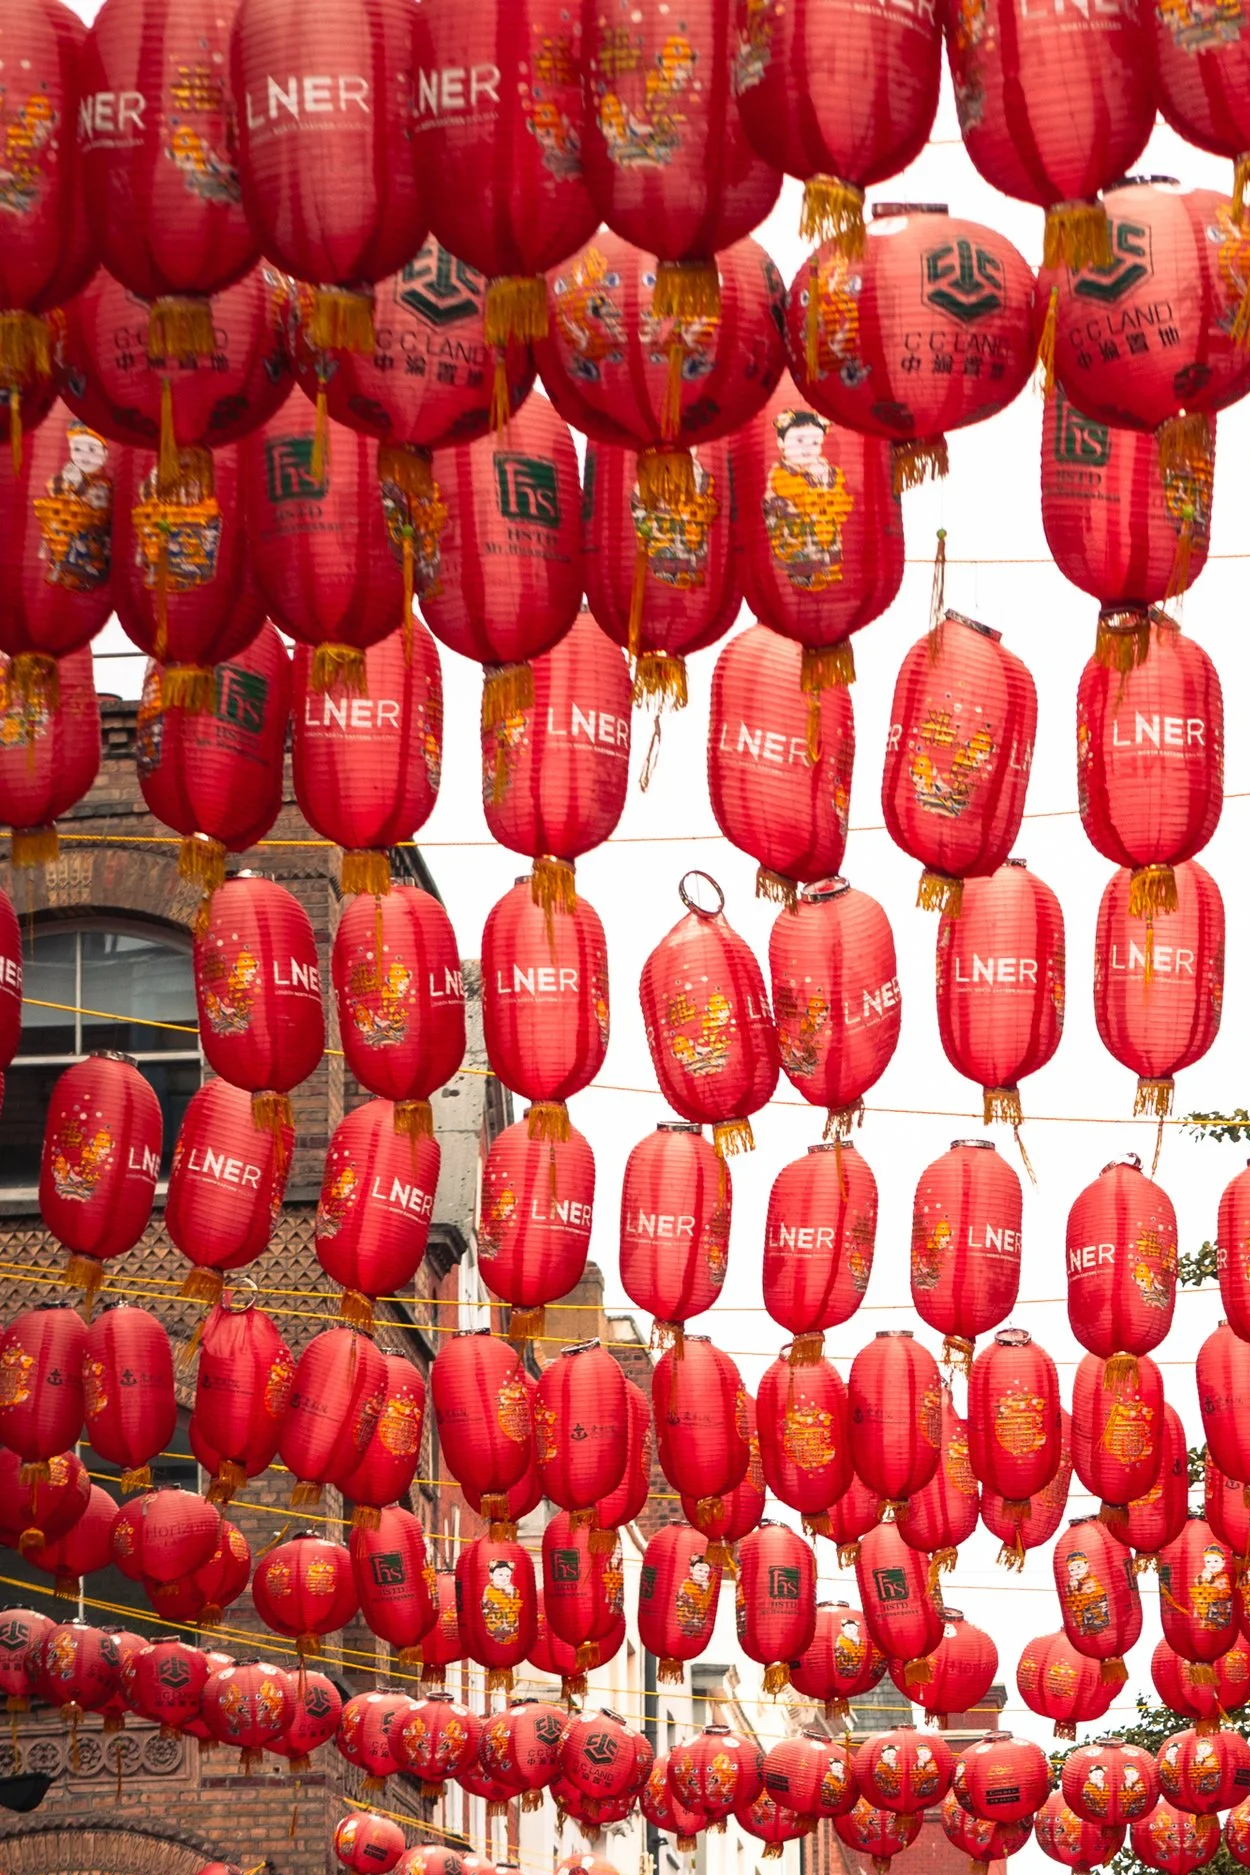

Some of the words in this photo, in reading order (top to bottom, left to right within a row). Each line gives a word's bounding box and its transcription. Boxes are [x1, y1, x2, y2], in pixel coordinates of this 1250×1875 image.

[80, 91, 146, 137] NER
[246, 75, 370, 128] LNER
[305, 692, 400, 733] LNER
[548, 701, 628, 750] LNER
[1112, 711, 1206, 750] LNER
[719, 721, 810, 768] LNER
[274, 957, 318, 989] LNE
[498, 965, 578, 996] LNER
[956, 953, 1037, 986] LNER
[188, 1146, 261, 1188] LNER
[373, 1176, 432, 1218] LNER
[533, 1198, 592, 1224] LNER
[626, 1208, 695, 1238] LNER
[769, 1220, 835, 1251] LNER
[1068, 1243, 1115, 1273] NER
[883, 1602, 908, 1611] HSTD
